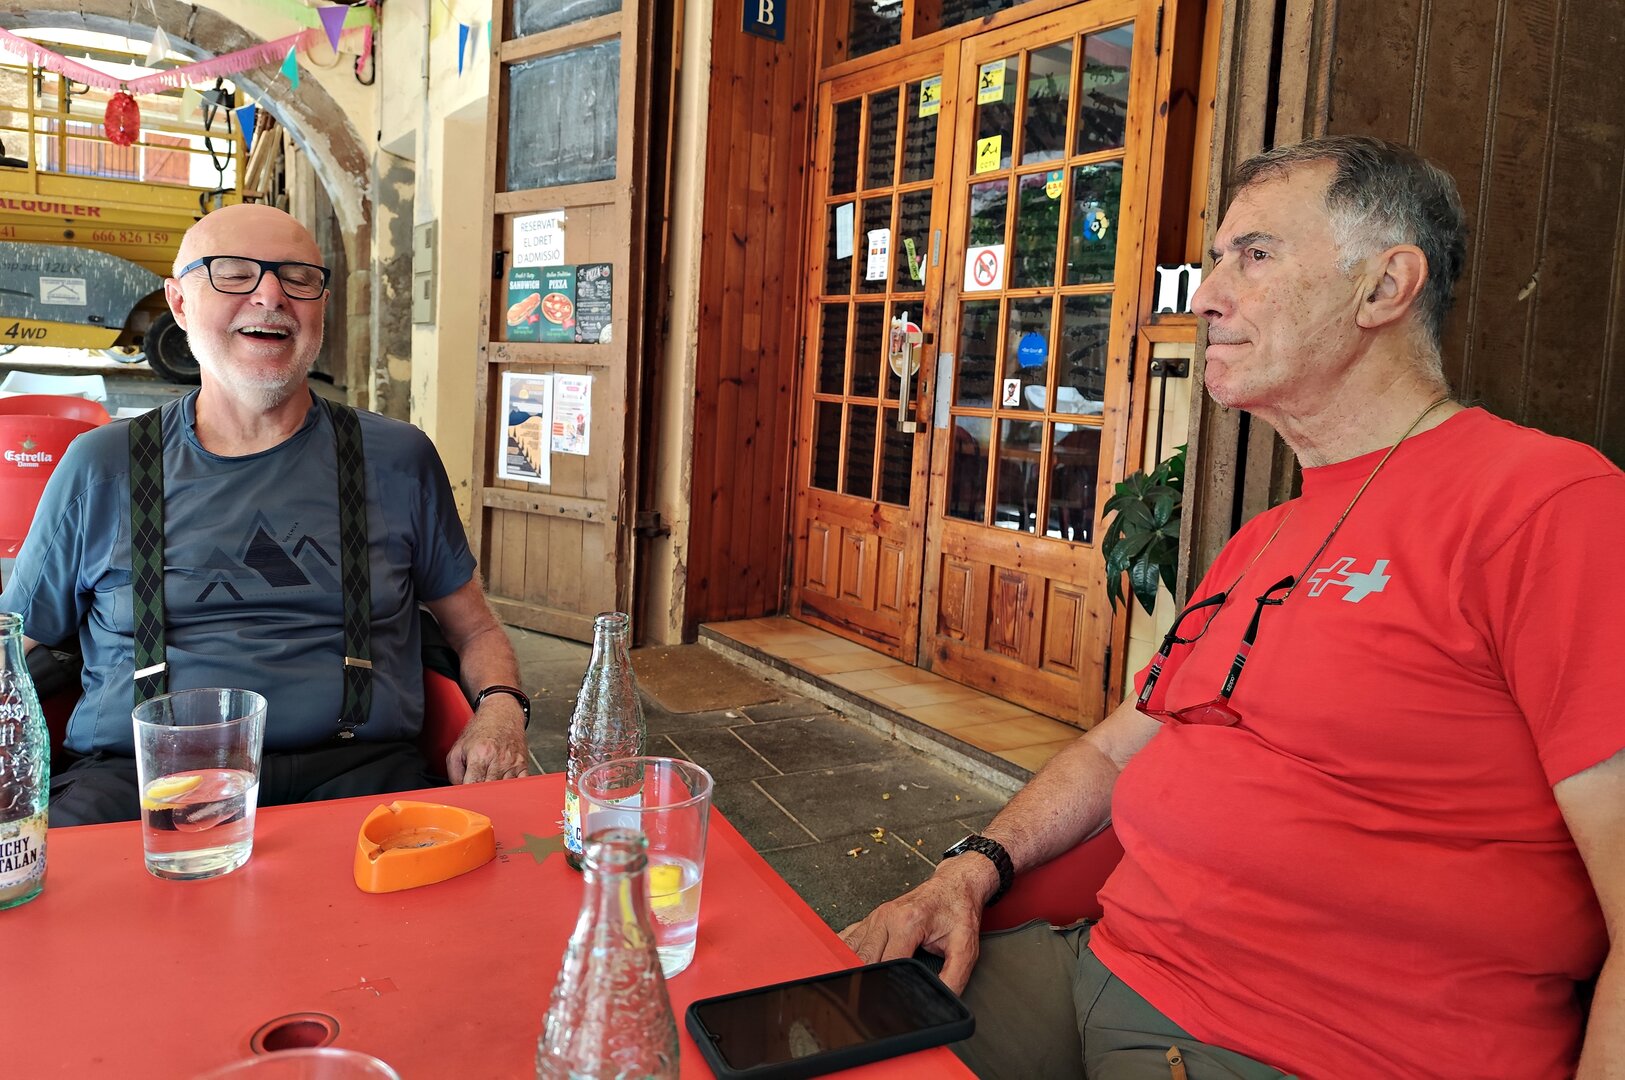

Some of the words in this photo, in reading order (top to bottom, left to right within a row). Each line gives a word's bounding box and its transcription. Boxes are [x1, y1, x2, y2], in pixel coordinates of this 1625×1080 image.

[520, 219, 555, 232] RESERVAT
[92, 230, 116, 242] 666
[119, 231, 142, 243] 826
[148, 232, 169, 244] 159
[524, 237, 532, 248] EL
[533, 235, 552, 247] DRET
[509, 280, 540, 290] SANDWICH
[4, 450, 53, 462] Estrella
